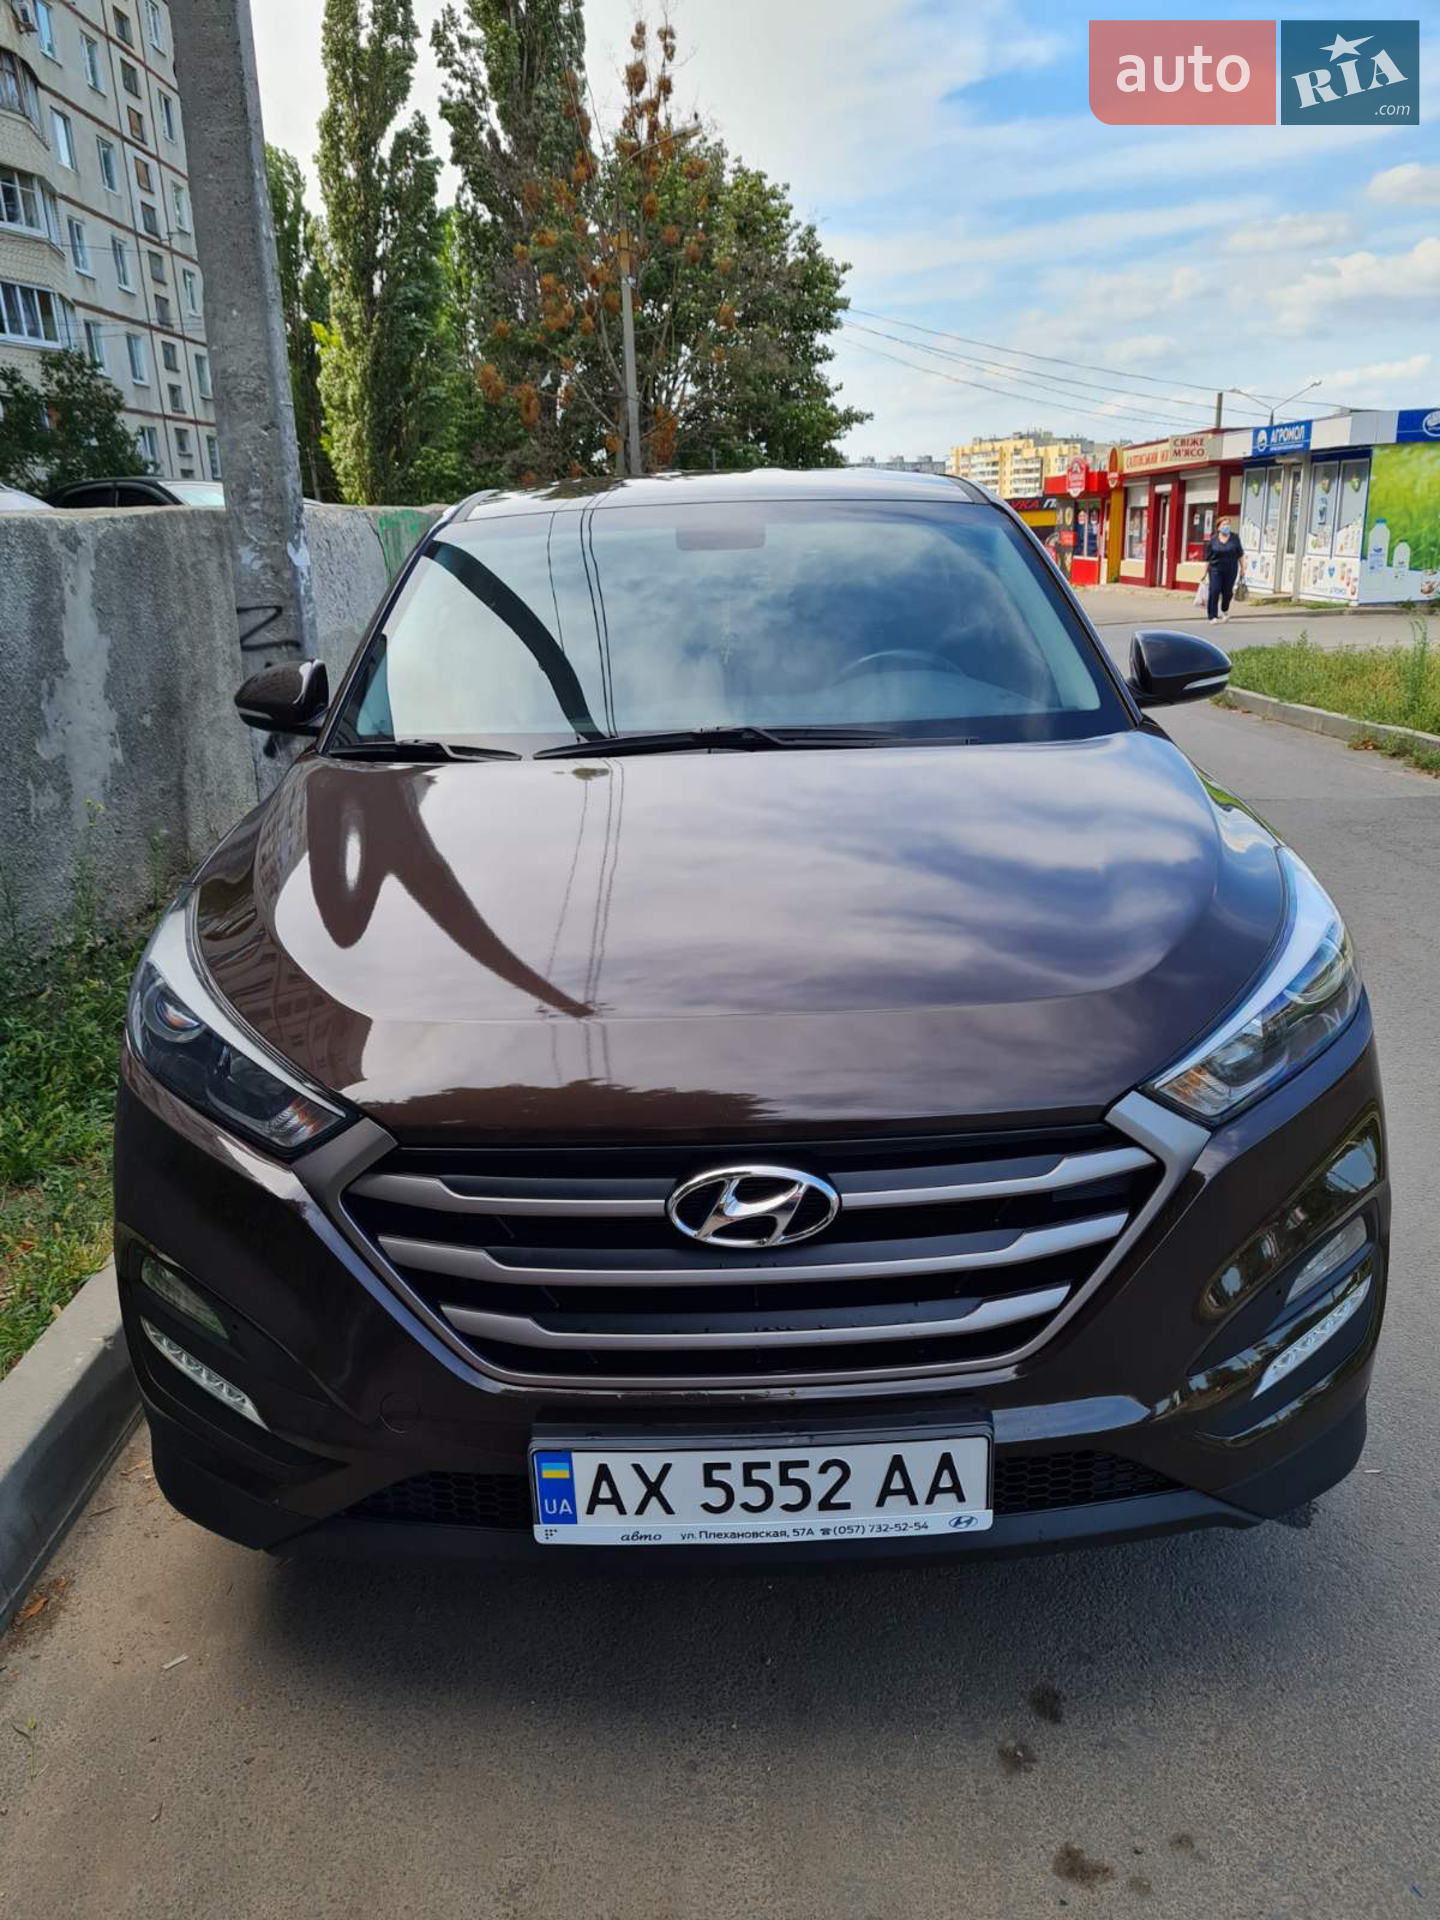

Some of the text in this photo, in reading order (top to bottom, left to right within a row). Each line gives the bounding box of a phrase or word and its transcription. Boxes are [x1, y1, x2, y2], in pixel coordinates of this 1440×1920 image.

[1173, 437, 1205, 448] СВІЖЕ
[1270, 425, 1305, 443] АГРОМОЛ
[1172, 448, 1205, 458] М'ЯСО
[585, 1451, 967, 1516] AX 5552 AA
[544, 1498, 574, 1515] UA
[620, 1521, 930, 1542] авто ул. Плехановская, 57А (057) 732-52-54
